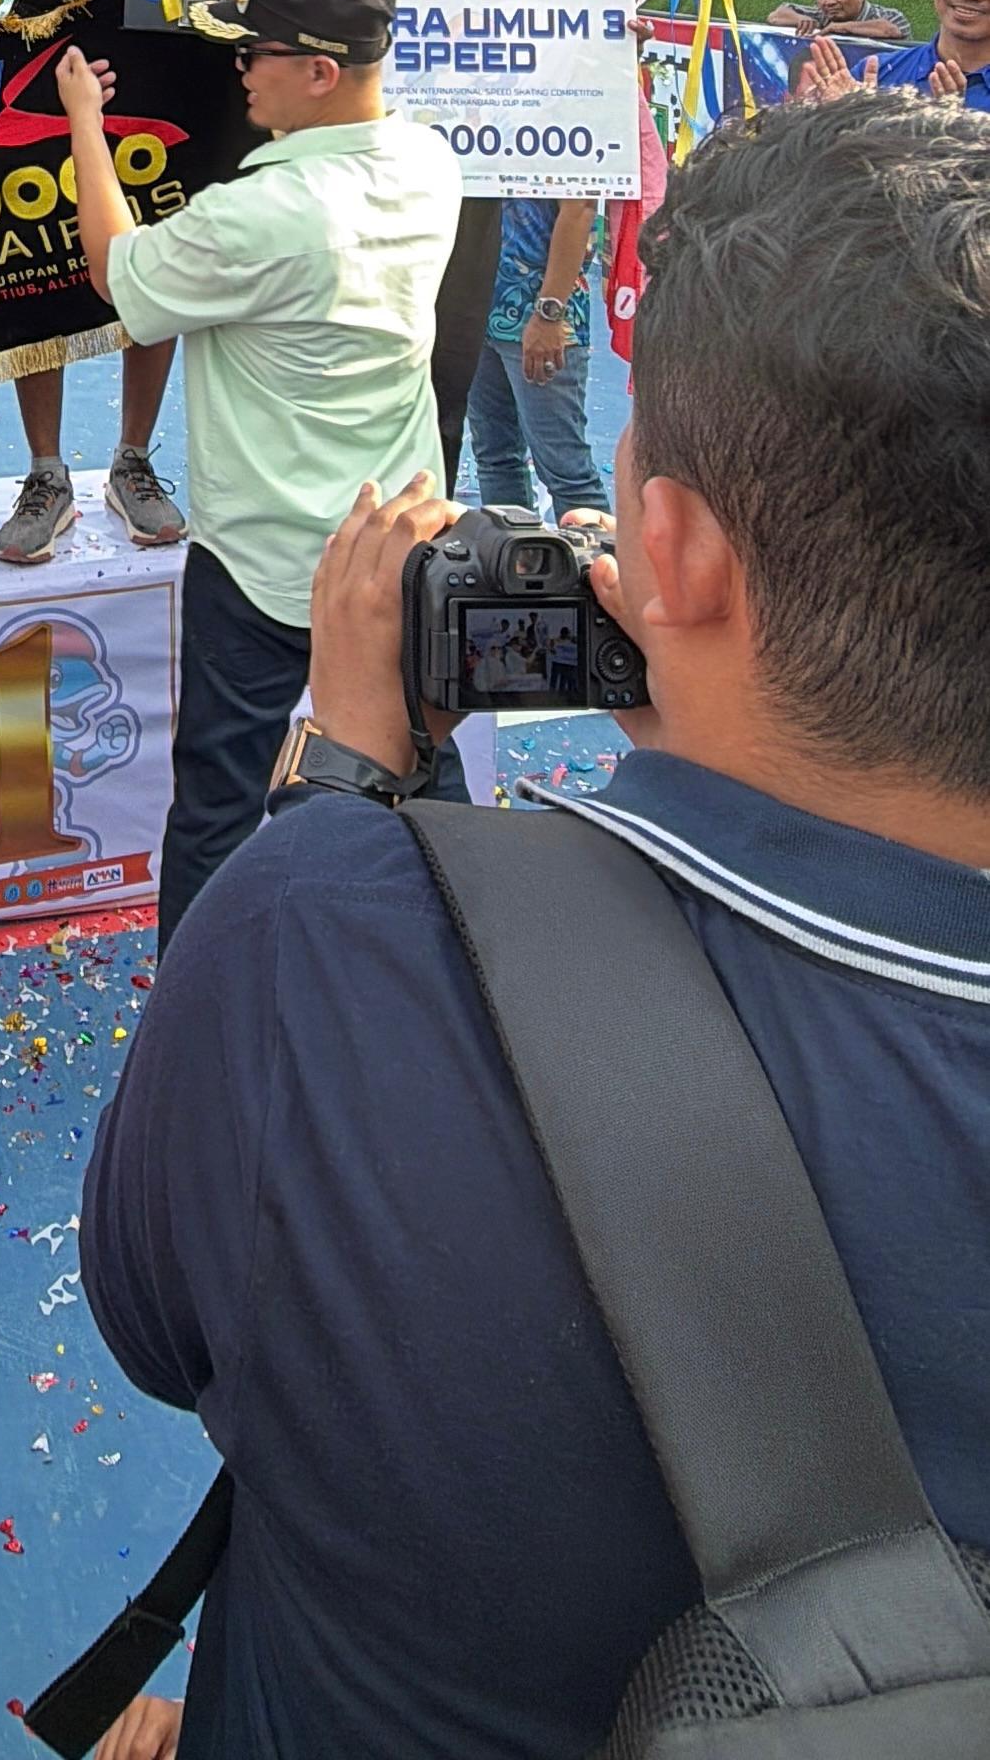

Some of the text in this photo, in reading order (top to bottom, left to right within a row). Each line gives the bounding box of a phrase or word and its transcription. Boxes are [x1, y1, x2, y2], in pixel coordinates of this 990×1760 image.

[392, 7, 626, 41] RA UMUM 3
[394, 41, 537, 73] SPEED
[396, 87, 418, 95] OPEN
[420, 88, 483, 96] INTERNASIONAL
[485, 88, 511, 97] SPEED
[513, 88, 549, 97] SKATING
[550, 89, 604, 98] COMPETITION
[406, 98, 448, 106] WALIKOTA
[450, 98, 501, 107] PEKANBARU
[502, 99, 520, 107] CUP
[430, 124, 621, 164] 00.000,-
[86, 867, 121, 886] AMAN
